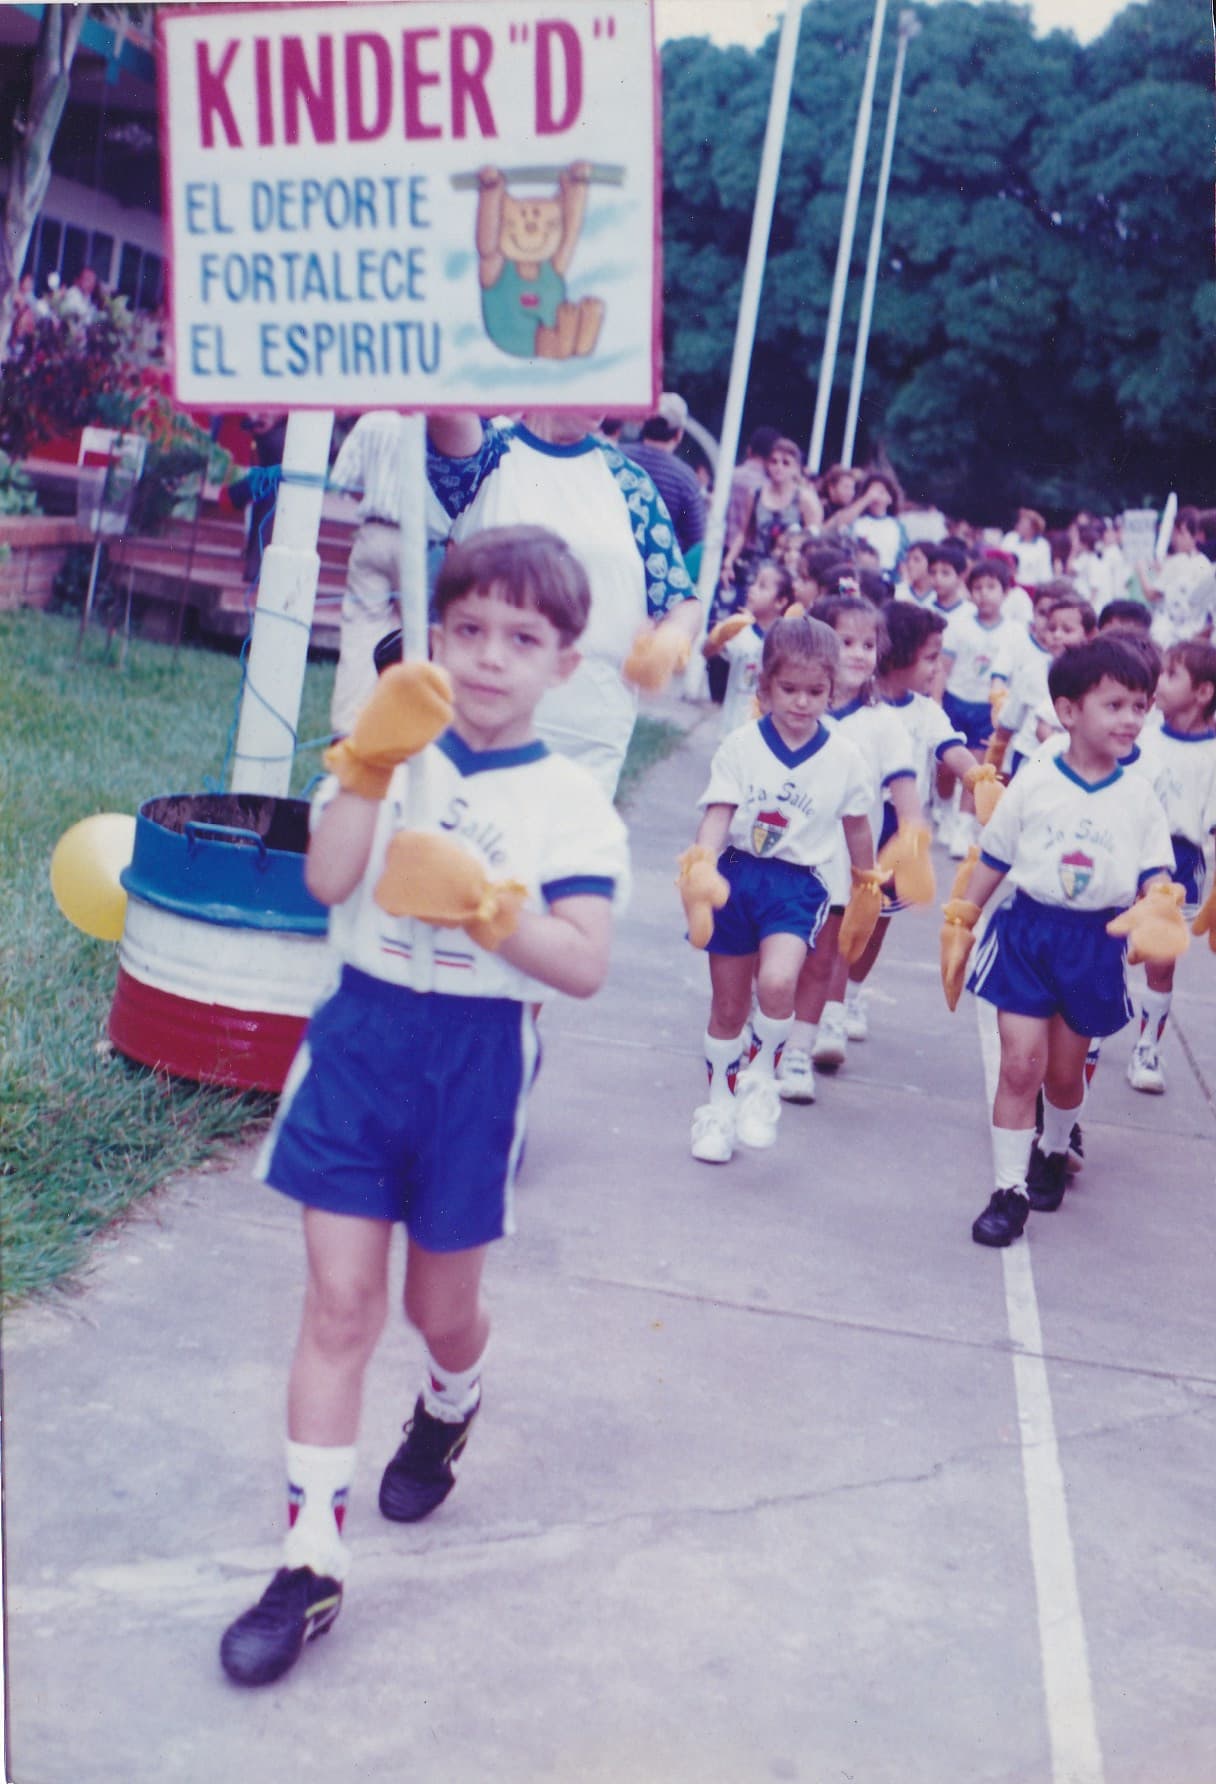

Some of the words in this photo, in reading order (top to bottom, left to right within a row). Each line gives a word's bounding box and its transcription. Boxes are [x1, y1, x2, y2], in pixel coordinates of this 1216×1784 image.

[196, 24, 498, 149] KINDER
[509, 16, 616, 137] "D"
[185, 182, 234, 235] EL
[251, 175, 432, 233] DEPORTE
[202, 248, 427, 303] FORTALECE
[191, 323, 237, 377] EL
[261, 321, 441, 377] ESPIRITU
[777, 782, 816, 817] Salle
[440, 797, 506, 866] Salle
